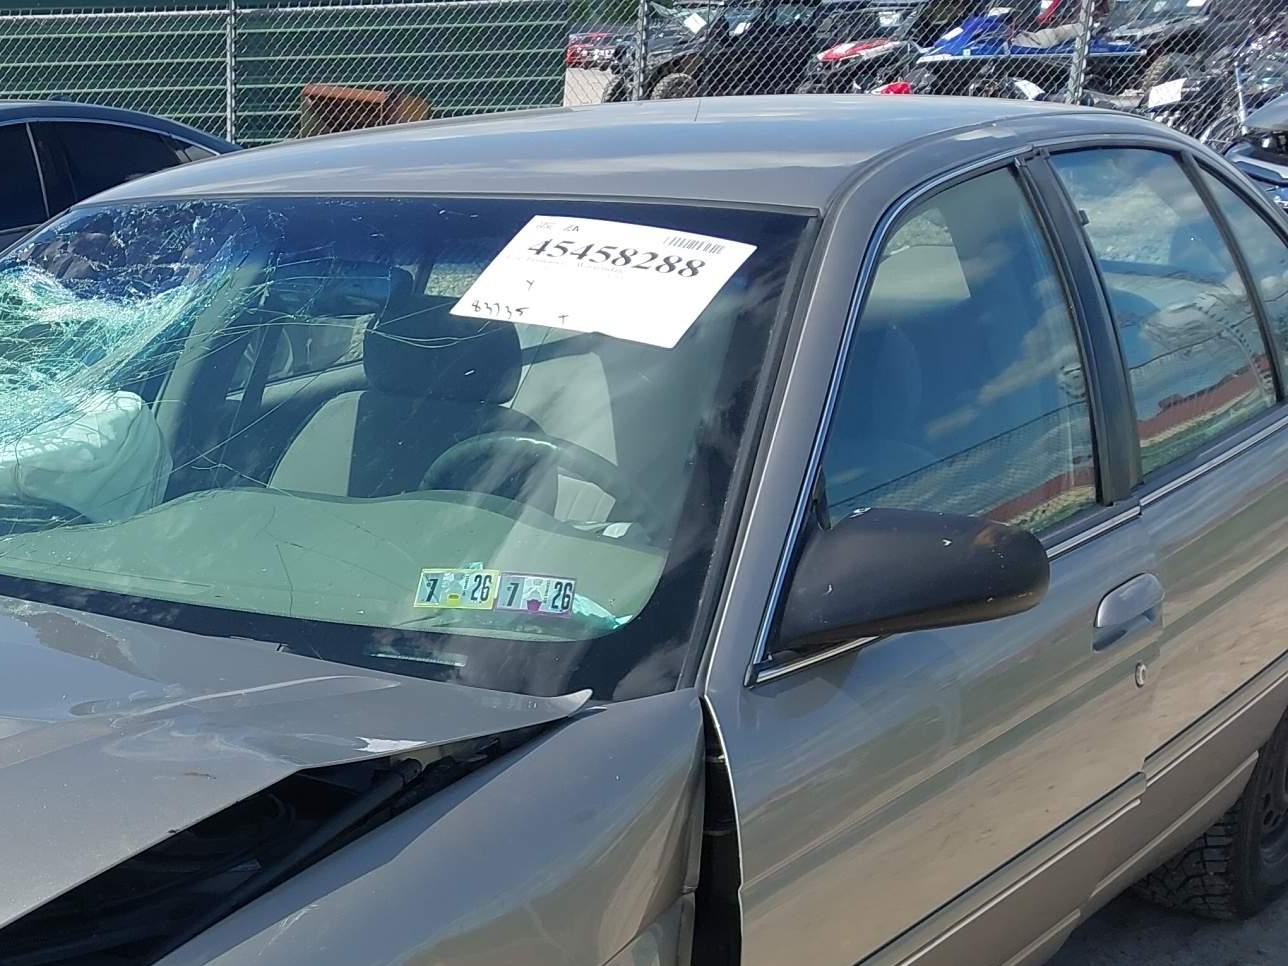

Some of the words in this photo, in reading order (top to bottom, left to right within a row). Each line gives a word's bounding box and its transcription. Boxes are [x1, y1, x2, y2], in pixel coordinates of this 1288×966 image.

[528, 238, 707, 278] 45458288
[426, 579, 439, 602] 7
[470, 575, 492, 602] 26
[507, 583, 520, 607] 7
[551, 581, 573, 611] 26
